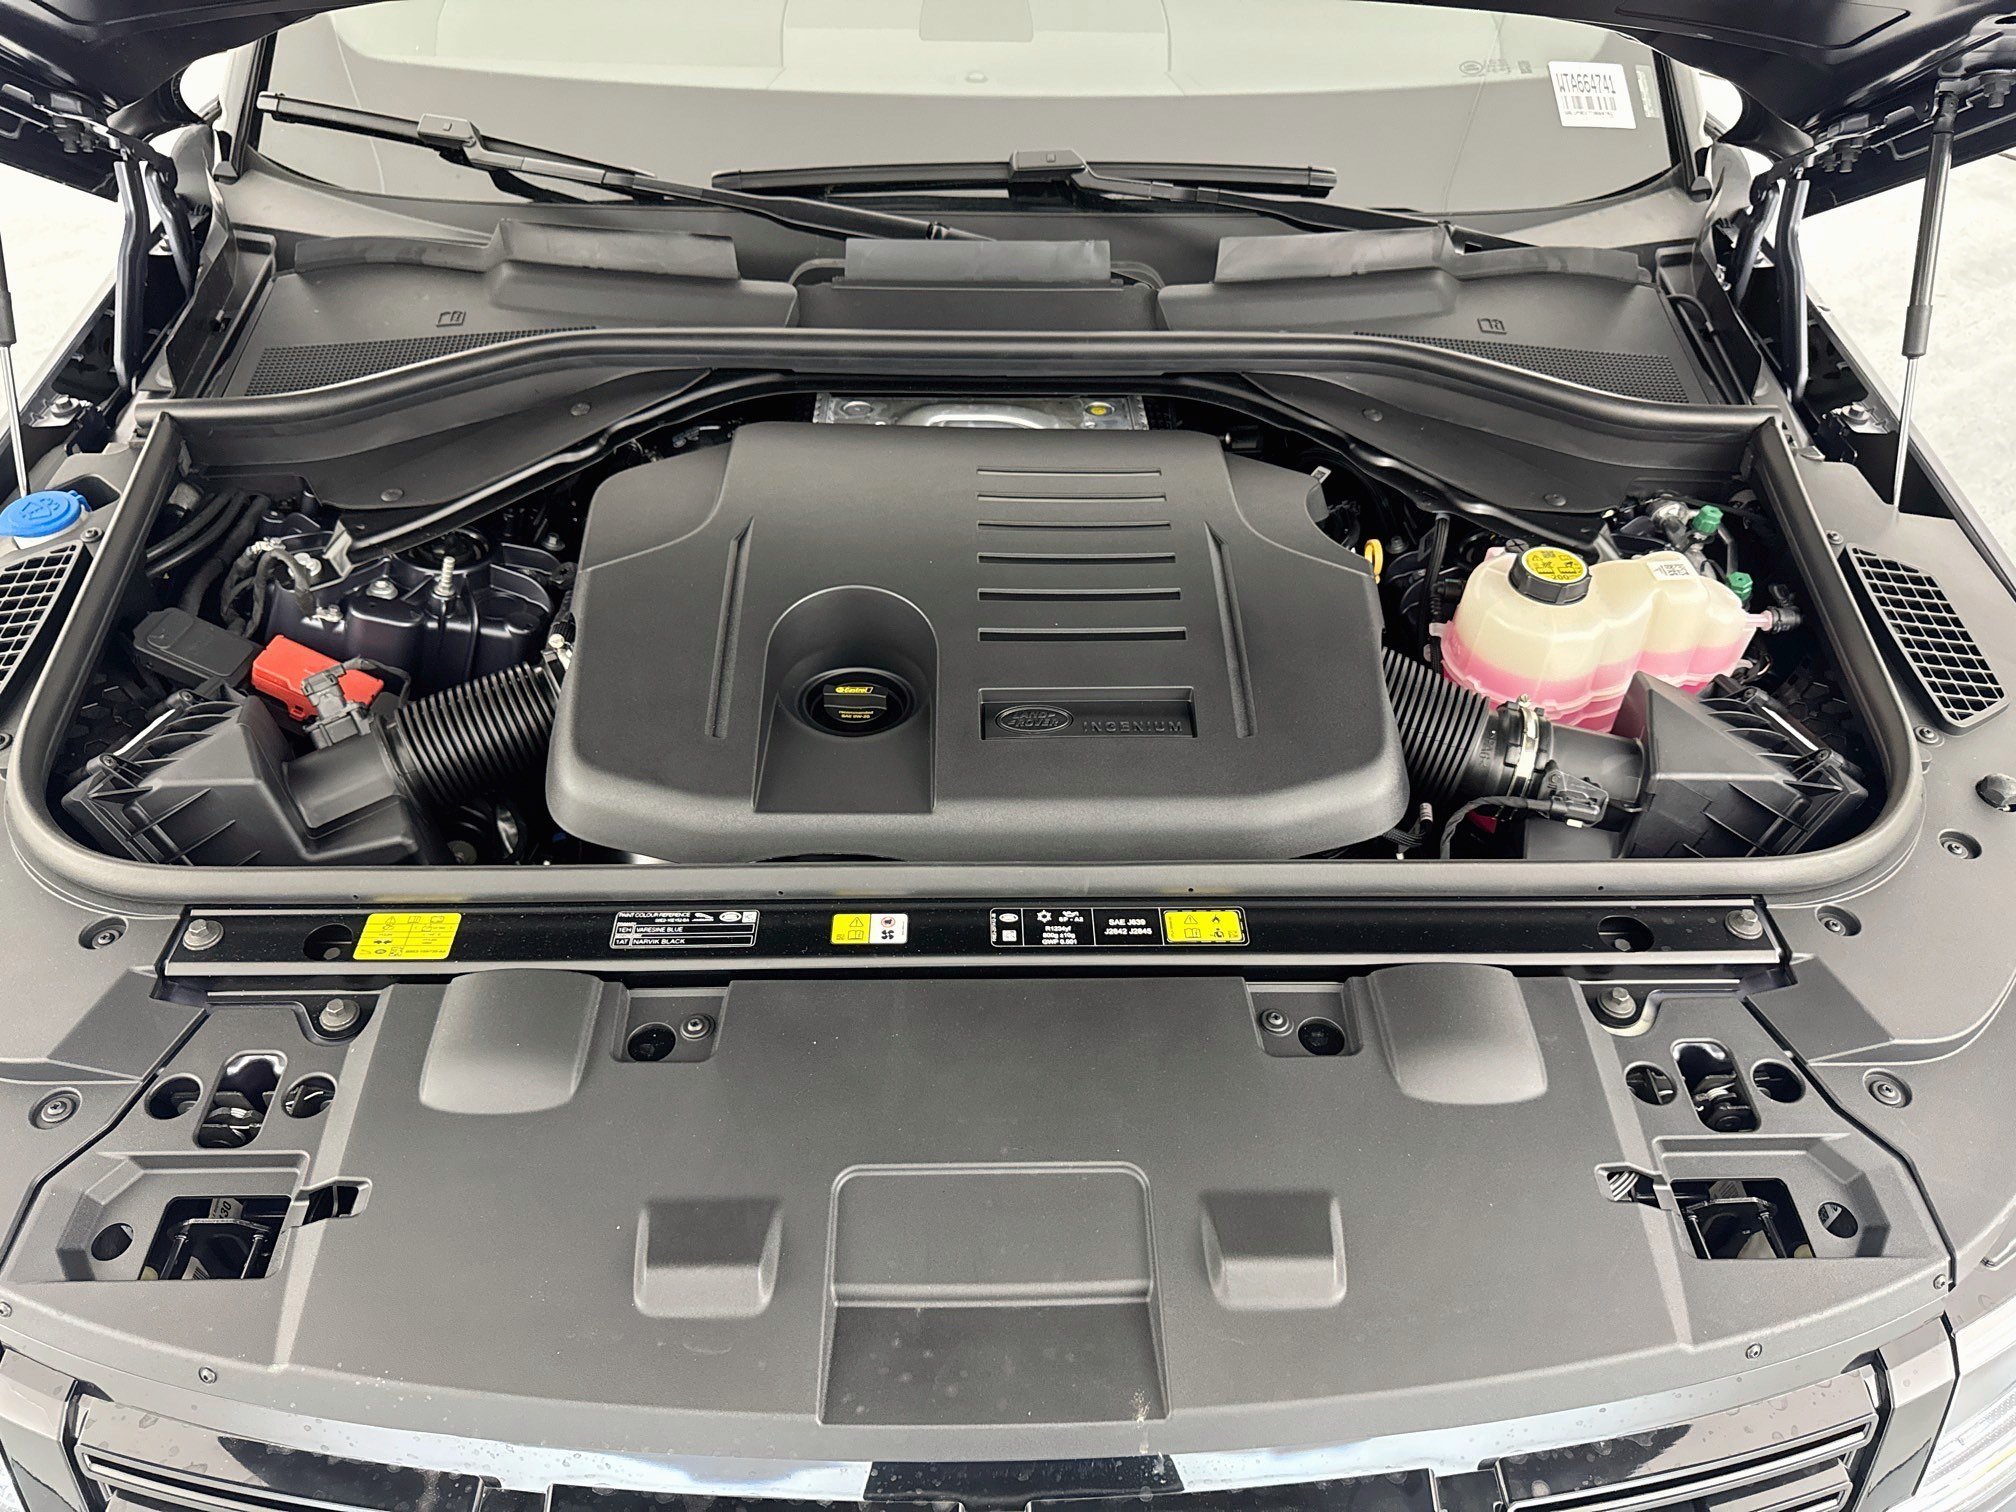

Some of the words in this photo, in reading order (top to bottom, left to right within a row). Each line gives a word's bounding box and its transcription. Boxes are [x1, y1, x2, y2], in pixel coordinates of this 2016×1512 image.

[1555, 73, 1617, 95] WTA664741
[1015, 719, 1060, 727] ROVER
[1082, 720, 1183, 733] INGENIUM
[219, 1201, 232, 1218] 30
